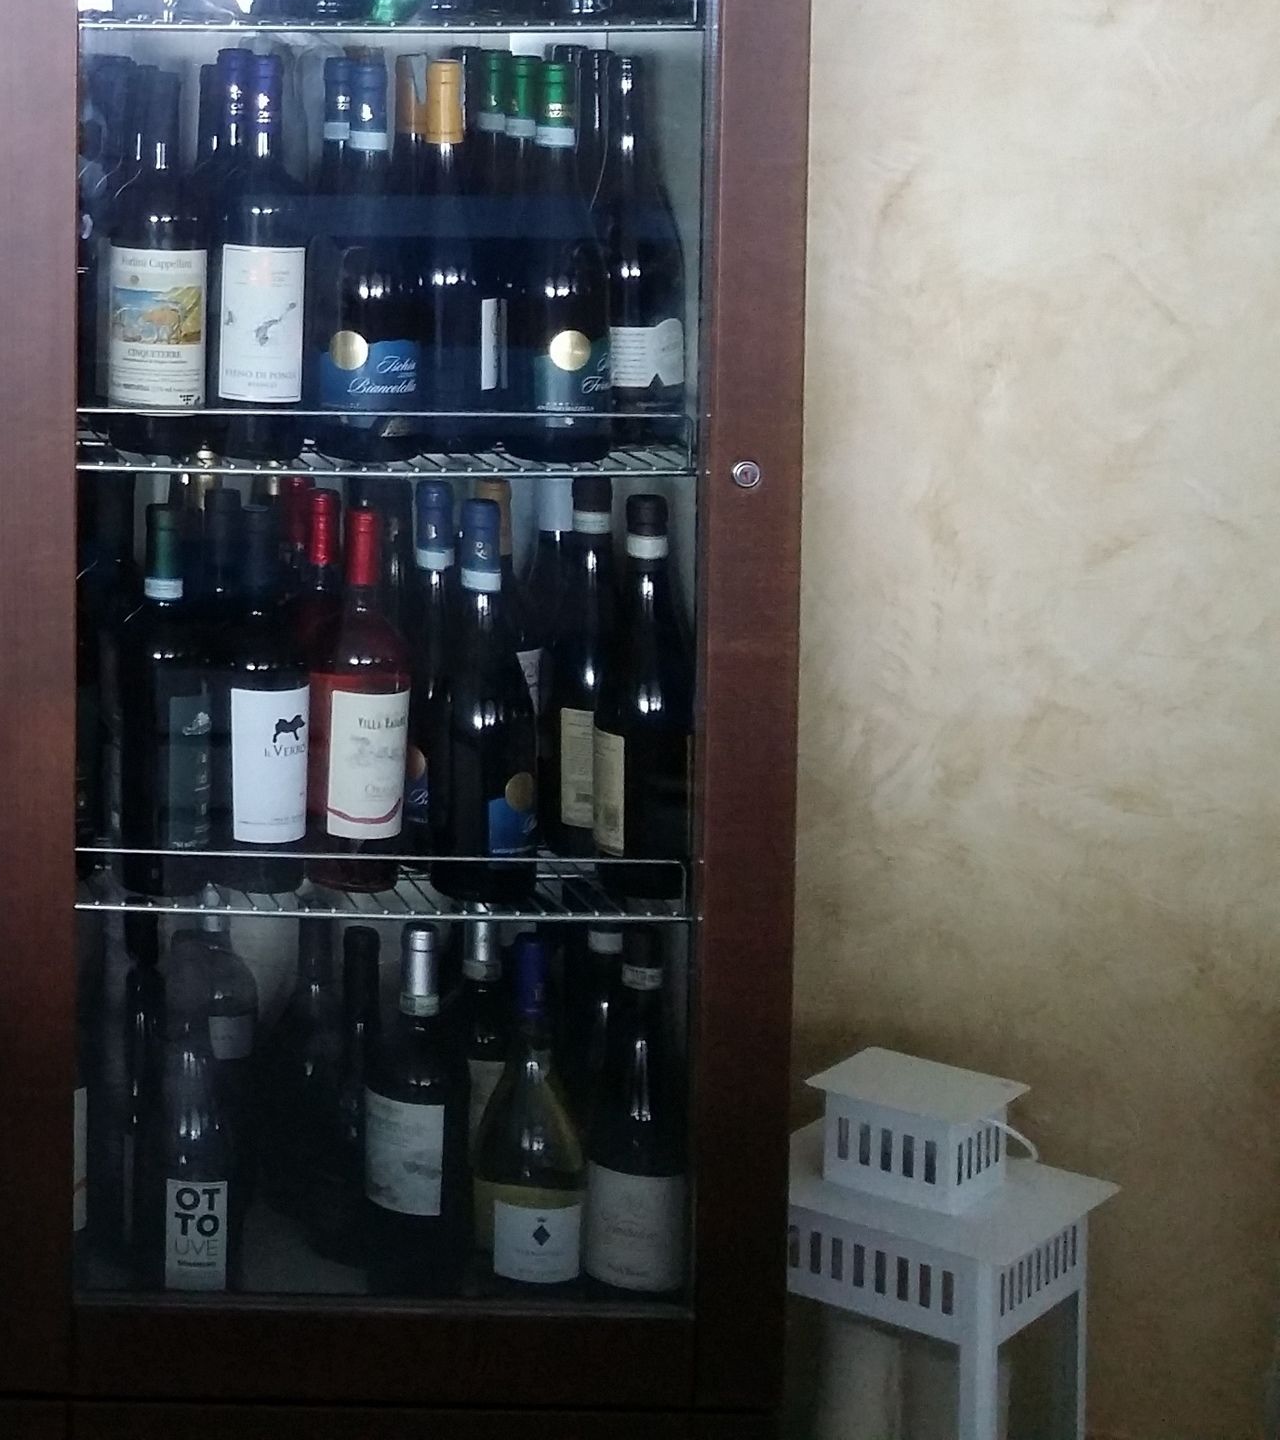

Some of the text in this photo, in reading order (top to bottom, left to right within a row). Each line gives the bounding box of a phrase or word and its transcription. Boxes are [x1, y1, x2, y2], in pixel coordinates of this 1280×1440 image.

[176, 1187, 220, 1211] OT
[175, 1212, 220, 1237] TO
[175, 1238, 219, 1257] UVE
